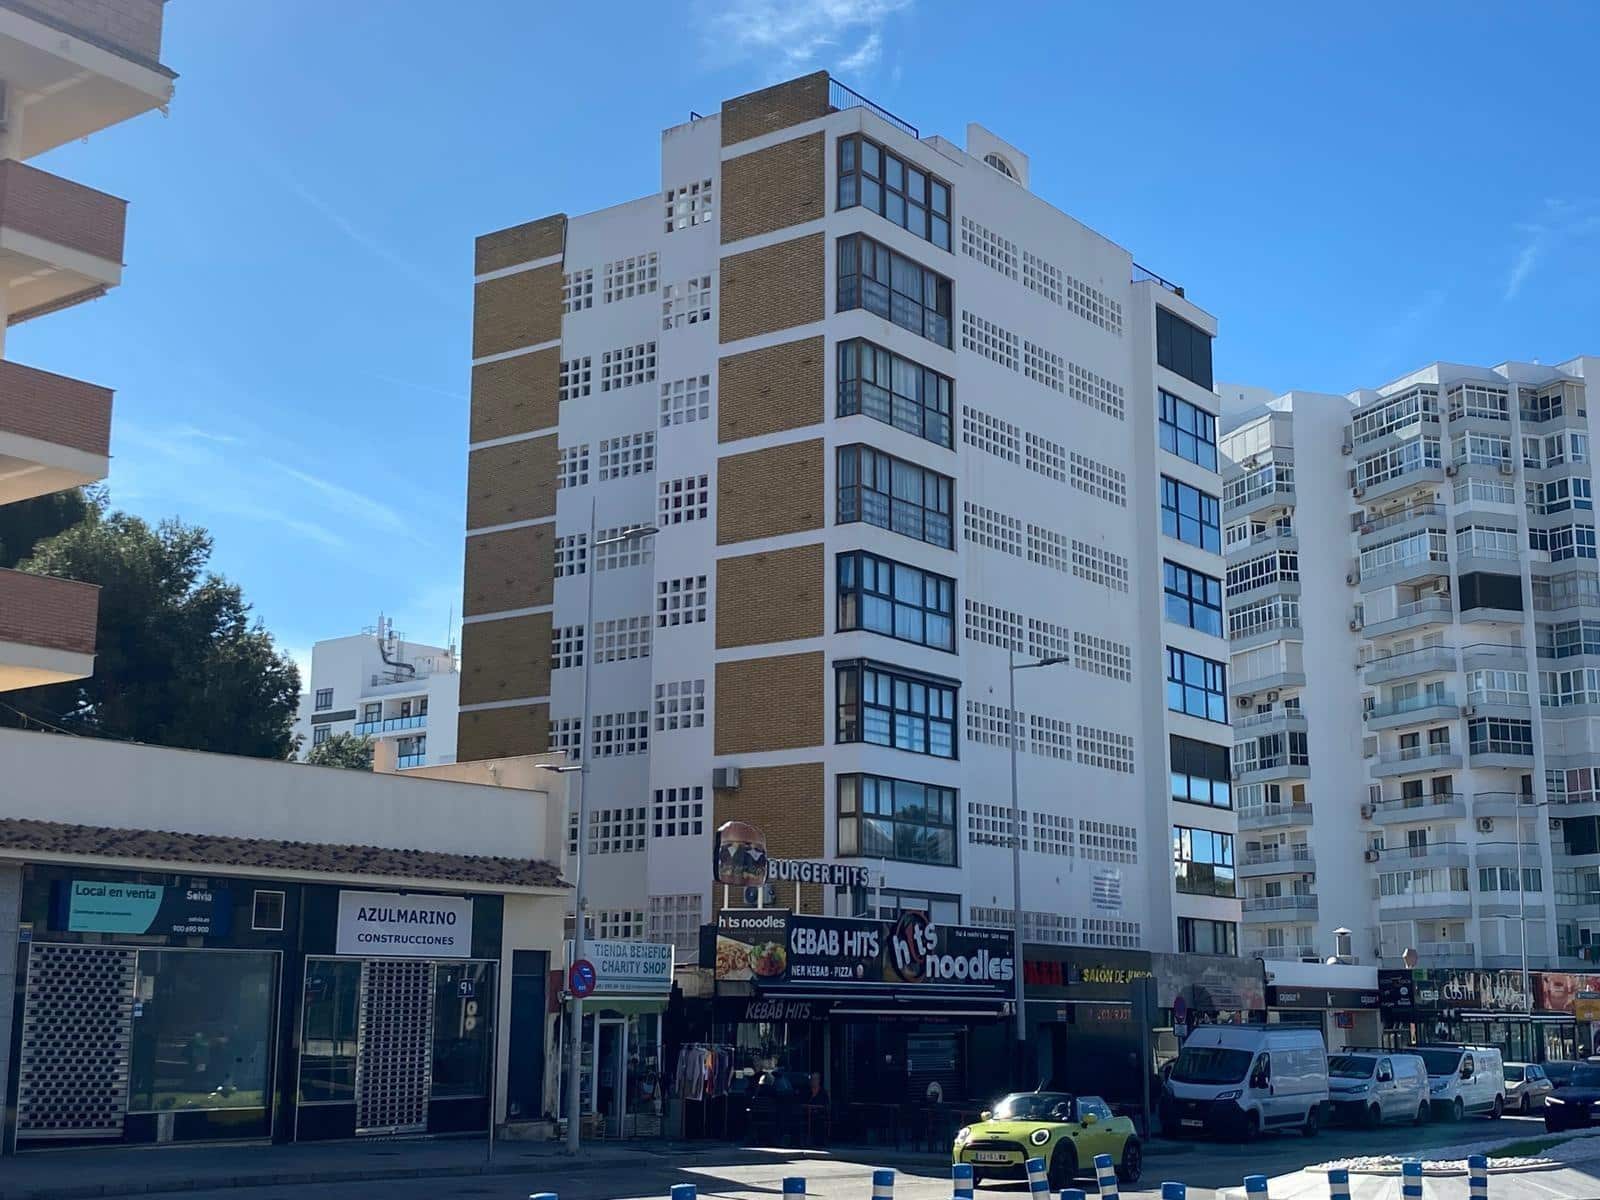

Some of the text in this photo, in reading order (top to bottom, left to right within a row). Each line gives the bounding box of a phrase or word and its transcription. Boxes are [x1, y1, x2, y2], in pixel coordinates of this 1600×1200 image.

[769, 861, 870, 887] BURGER HITS
[75, 884, 157, 899] Local en venta
[357, 907, 457, 925] AZULMARINO
[741, 915, 786, 928] noodles
[357, 933, 455, 945] CONSTRUCCIONES
[844, 930, 880, 958] HITS
[595, 944, 627, 958] TIENDA
[602, 960, 667, 974] CHARITY SHOP
[807, 965, 829, 977] KEBAB
[834, 966, 853, 978] PIZZA
[926, 949, 1014, 980] noodles
[1114, 970, 1125, 984] DE
[785, 1001, 810, 1019] HITS
